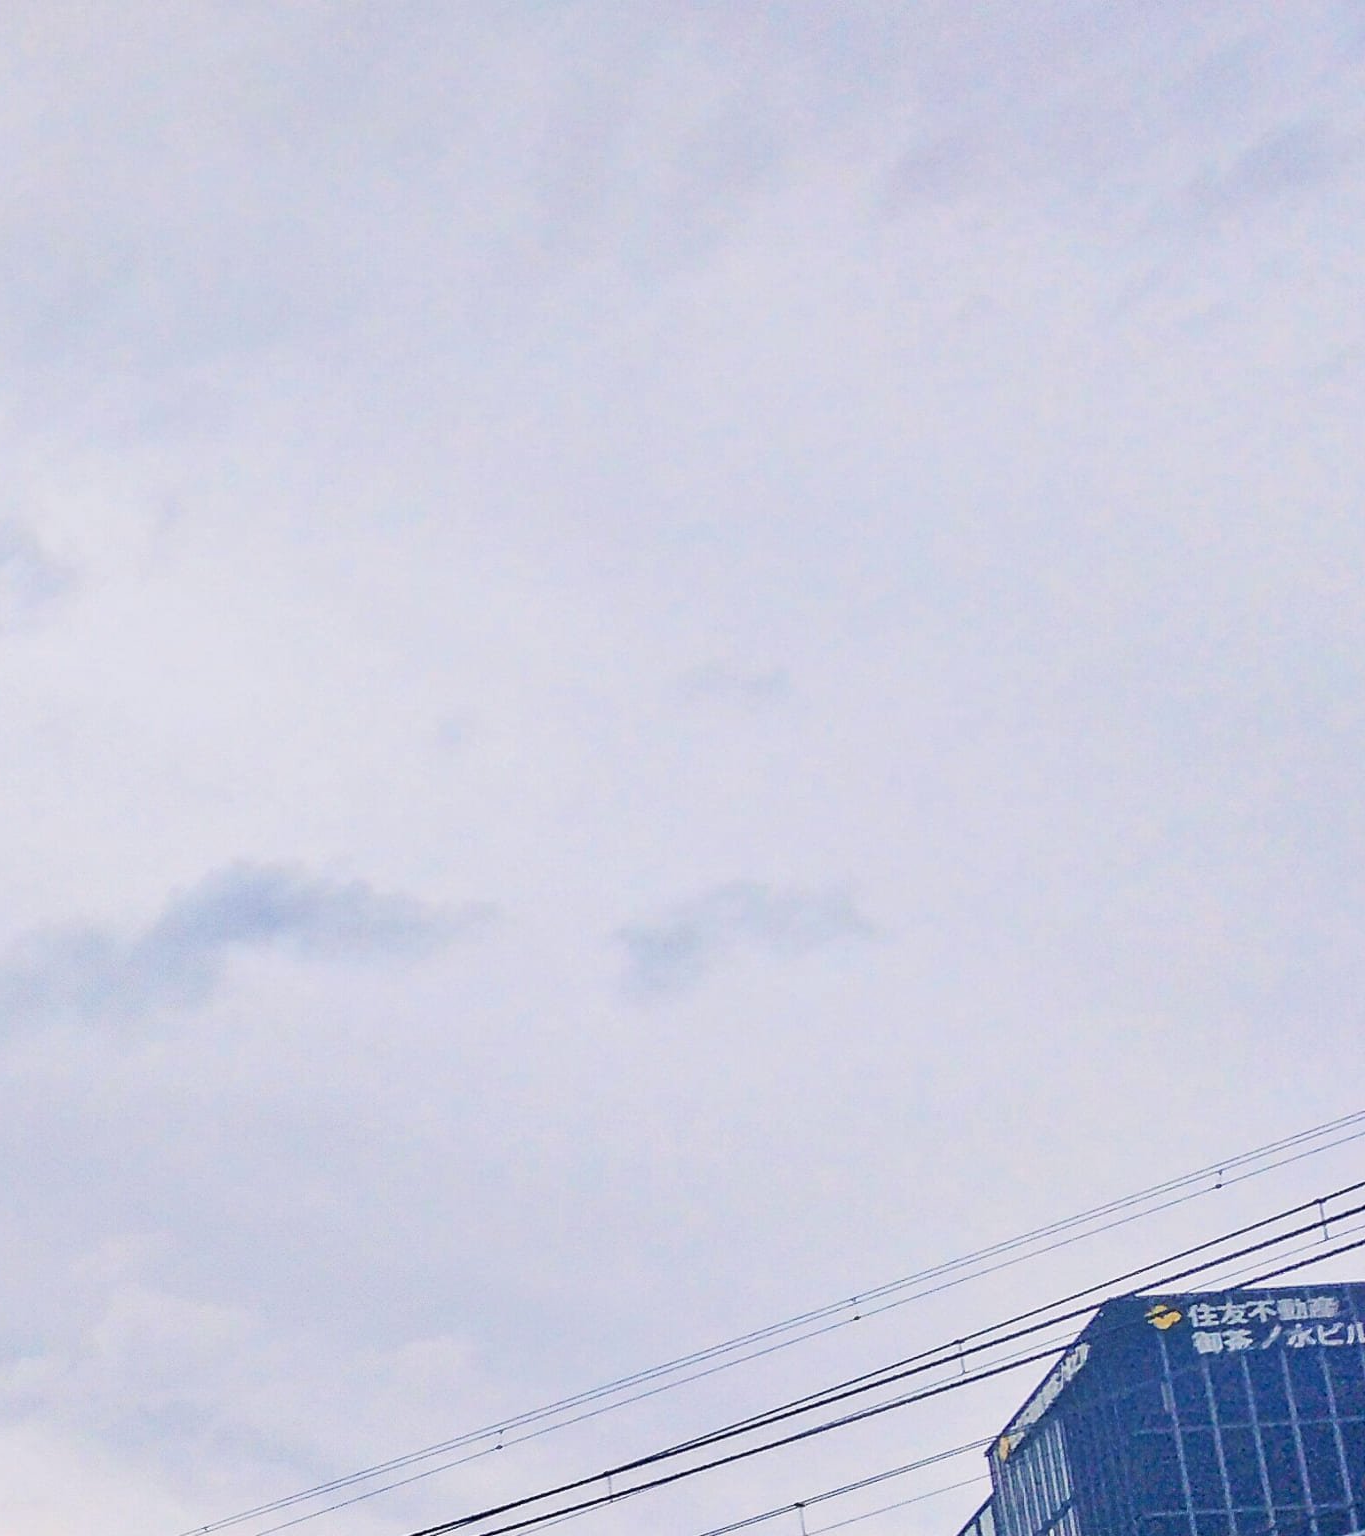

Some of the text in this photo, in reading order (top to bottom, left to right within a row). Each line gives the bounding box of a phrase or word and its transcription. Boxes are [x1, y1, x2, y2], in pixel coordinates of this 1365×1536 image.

[1187, 1296, 1340, 1328] 住友不動産
